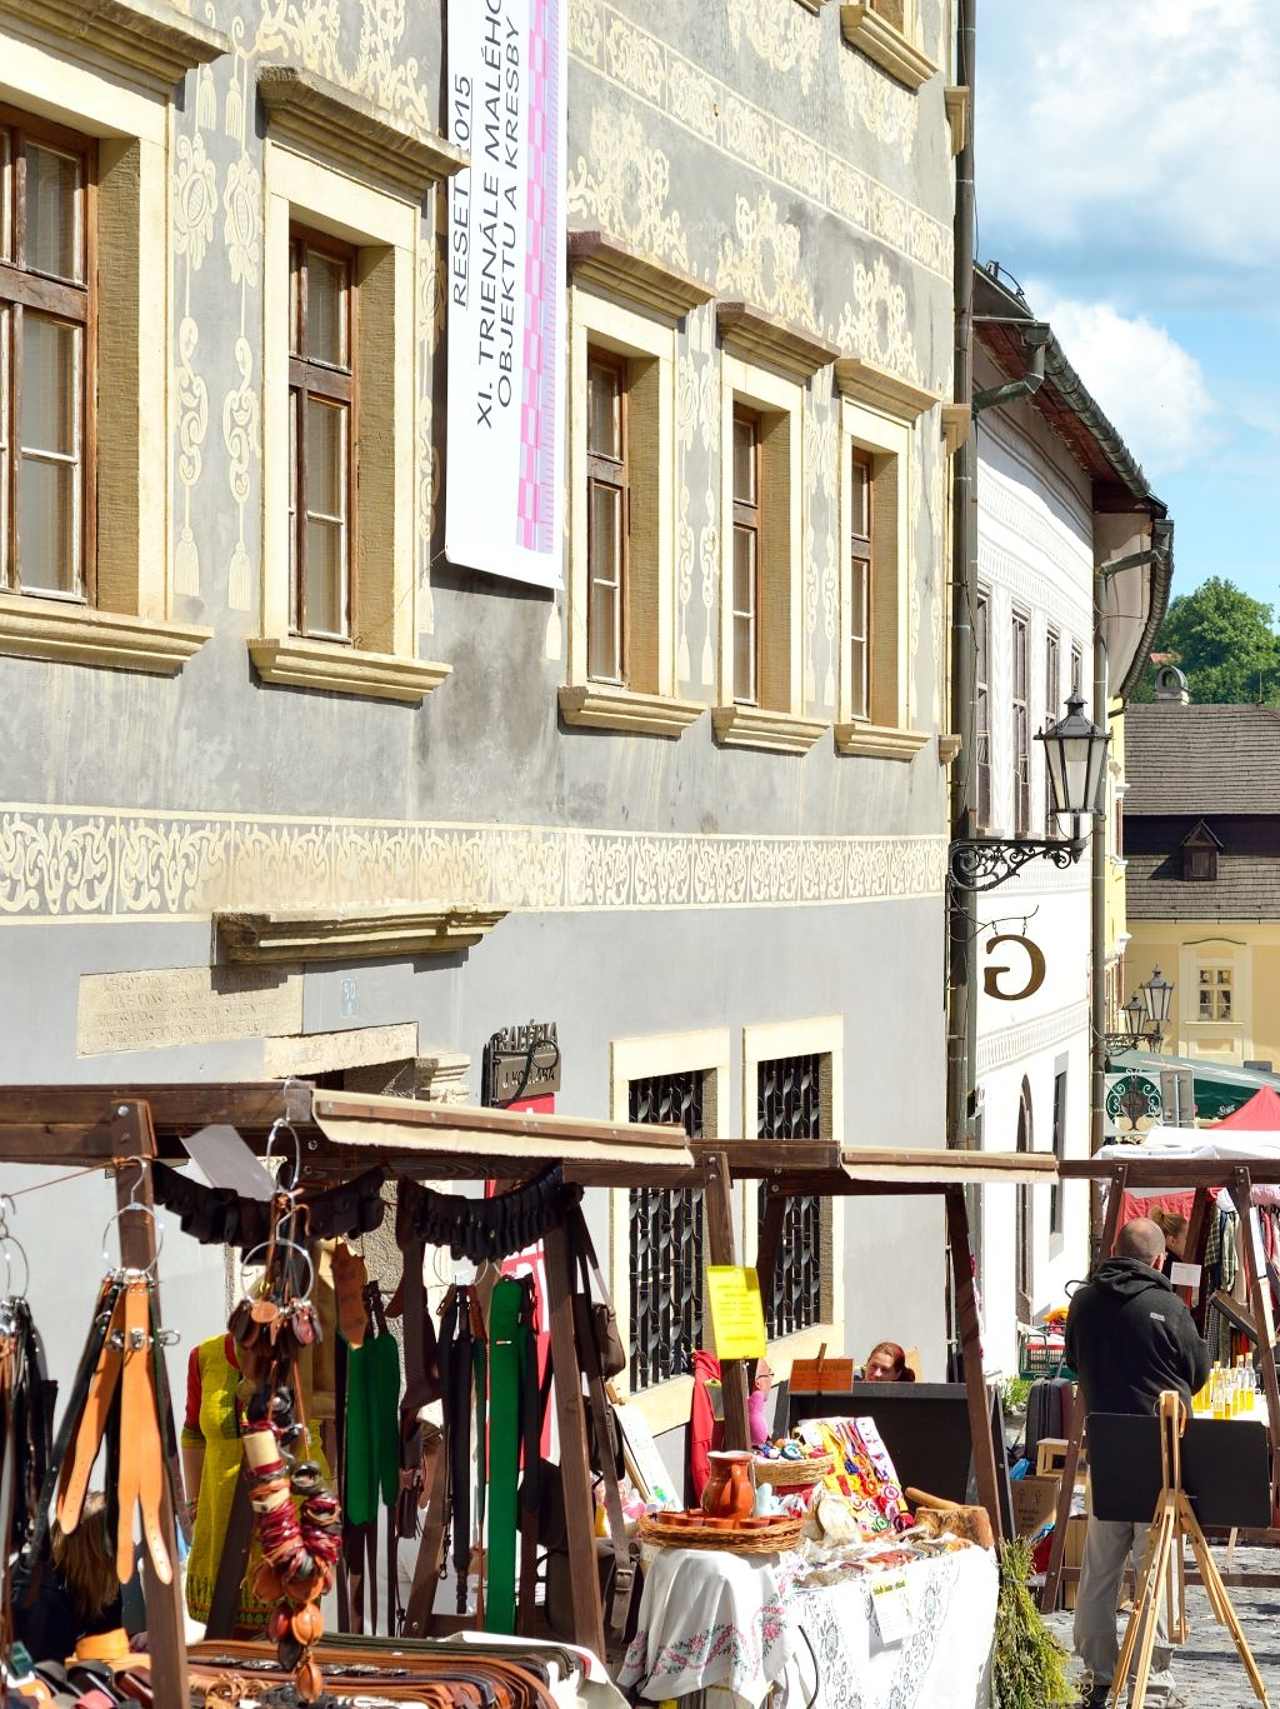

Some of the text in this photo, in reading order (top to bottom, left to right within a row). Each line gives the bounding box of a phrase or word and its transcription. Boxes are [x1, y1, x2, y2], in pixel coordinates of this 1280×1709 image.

[453, 73, 471, 307] RESET 015
[478, 172, 499, 366] TRIENÁLE
[498, 15, 520, 408] OBJEKTU A KRESBY
[477, 382, 493, 429] XI.
